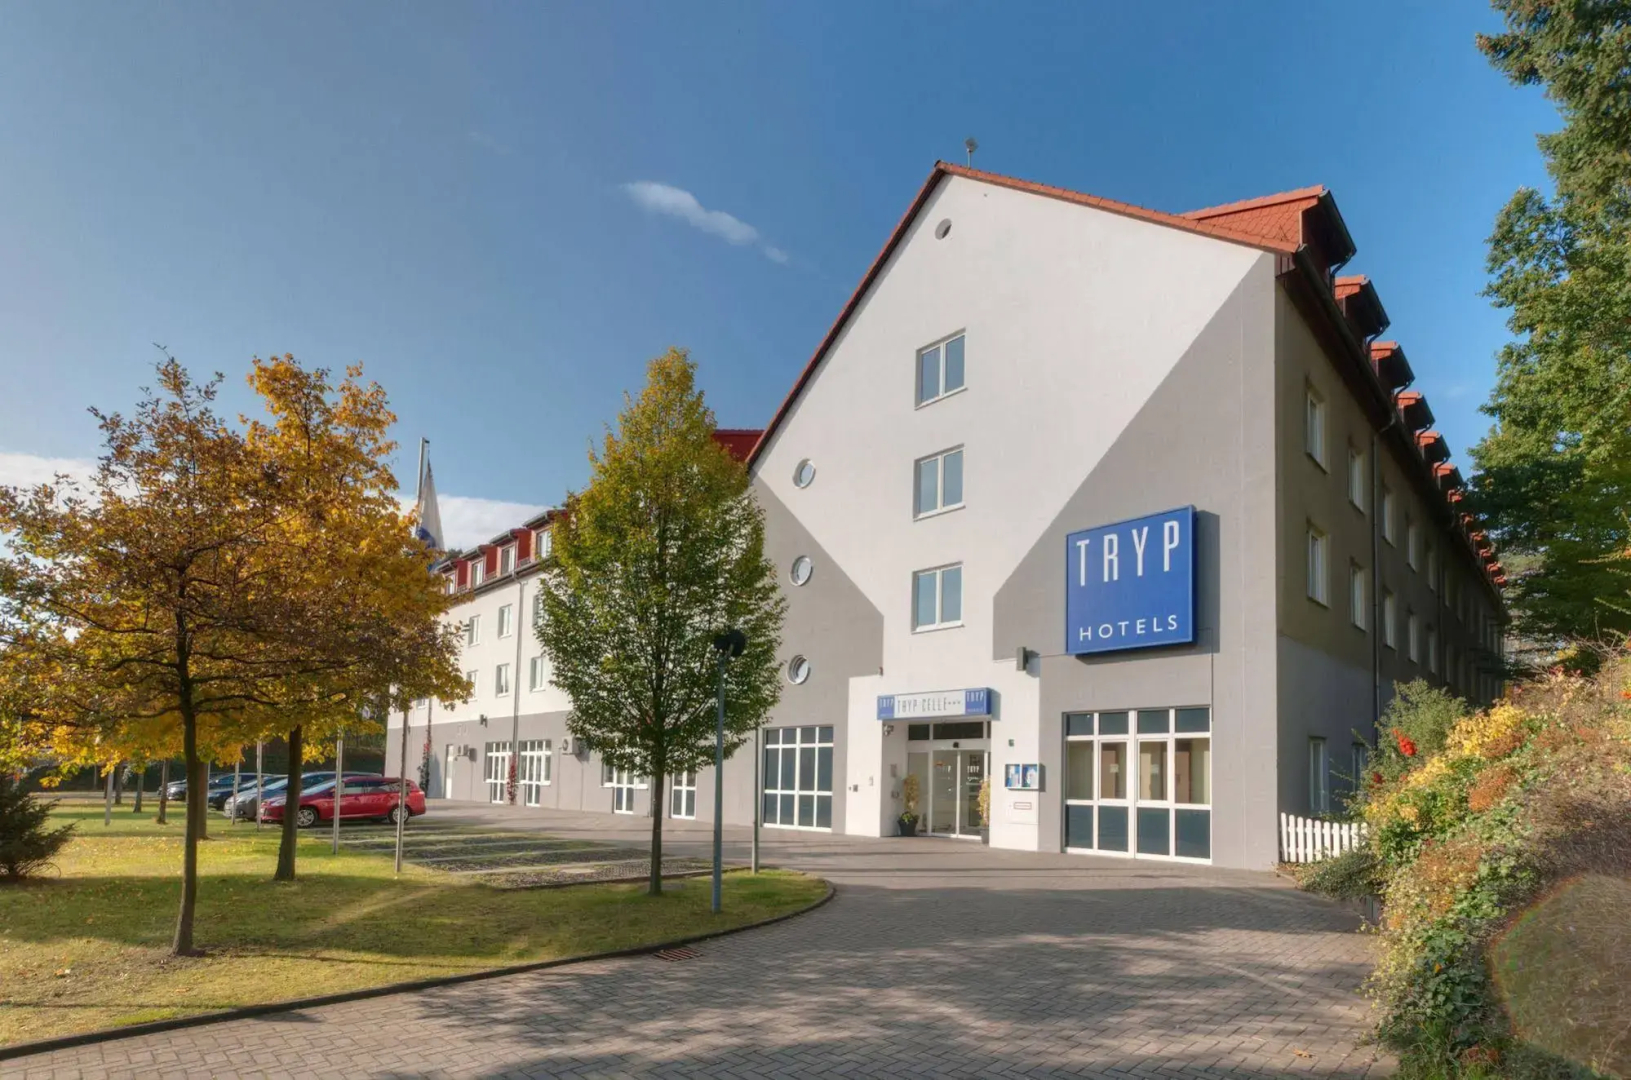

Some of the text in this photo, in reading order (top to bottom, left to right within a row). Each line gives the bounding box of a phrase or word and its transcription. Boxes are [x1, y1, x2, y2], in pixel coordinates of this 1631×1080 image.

[1076, 520, 1180, 587] TRYP
[1079, 614, 1178, 641] HOTELS
[897, 699, 918, 714] TRYP
